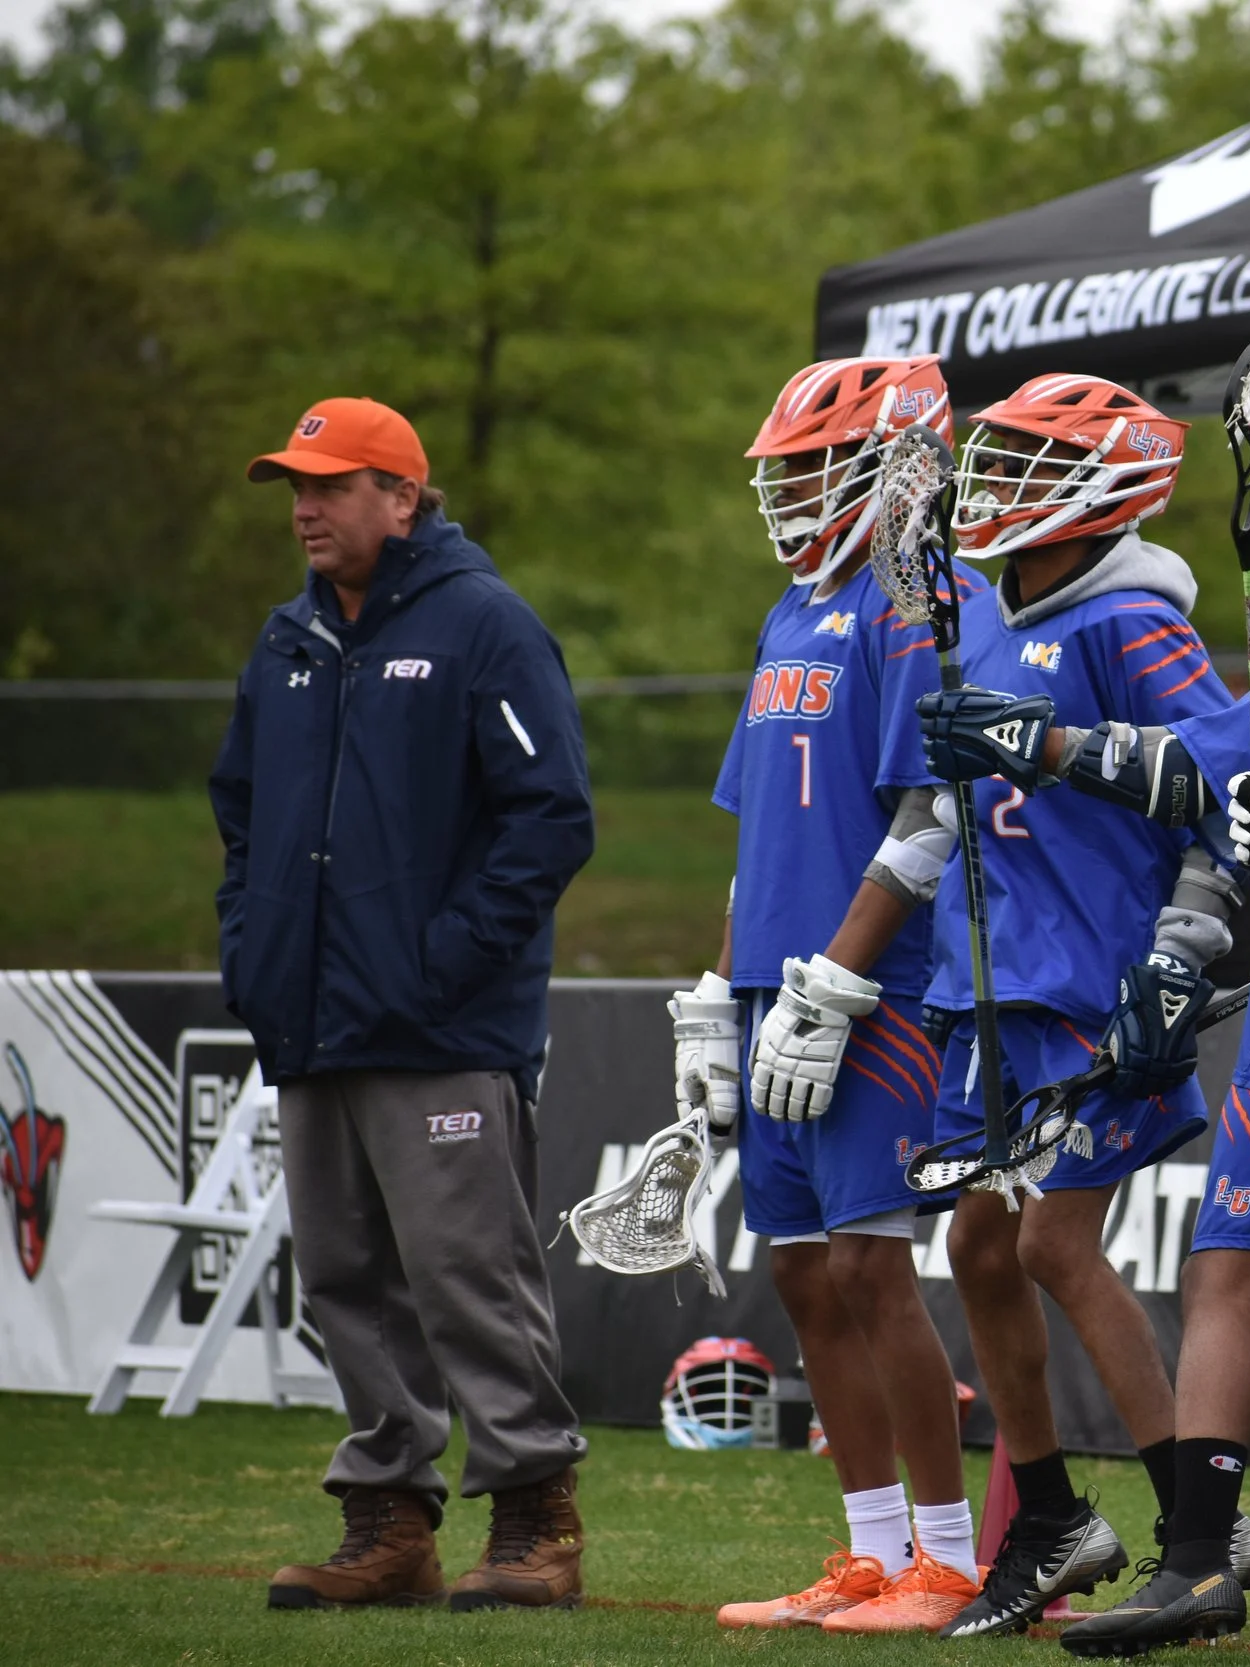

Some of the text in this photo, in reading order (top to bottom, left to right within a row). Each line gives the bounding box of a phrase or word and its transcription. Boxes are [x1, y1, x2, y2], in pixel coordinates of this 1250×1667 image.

[863, 292, 973, 360] NEXT
[966, 256, 1229, 356] COLLEGIATE
[300, 415, 326, 438] U
[383, 659, 432, 680] TEN
[792, 733, 813, 808] 1
[427, 1112, 481, 1133] TEN
